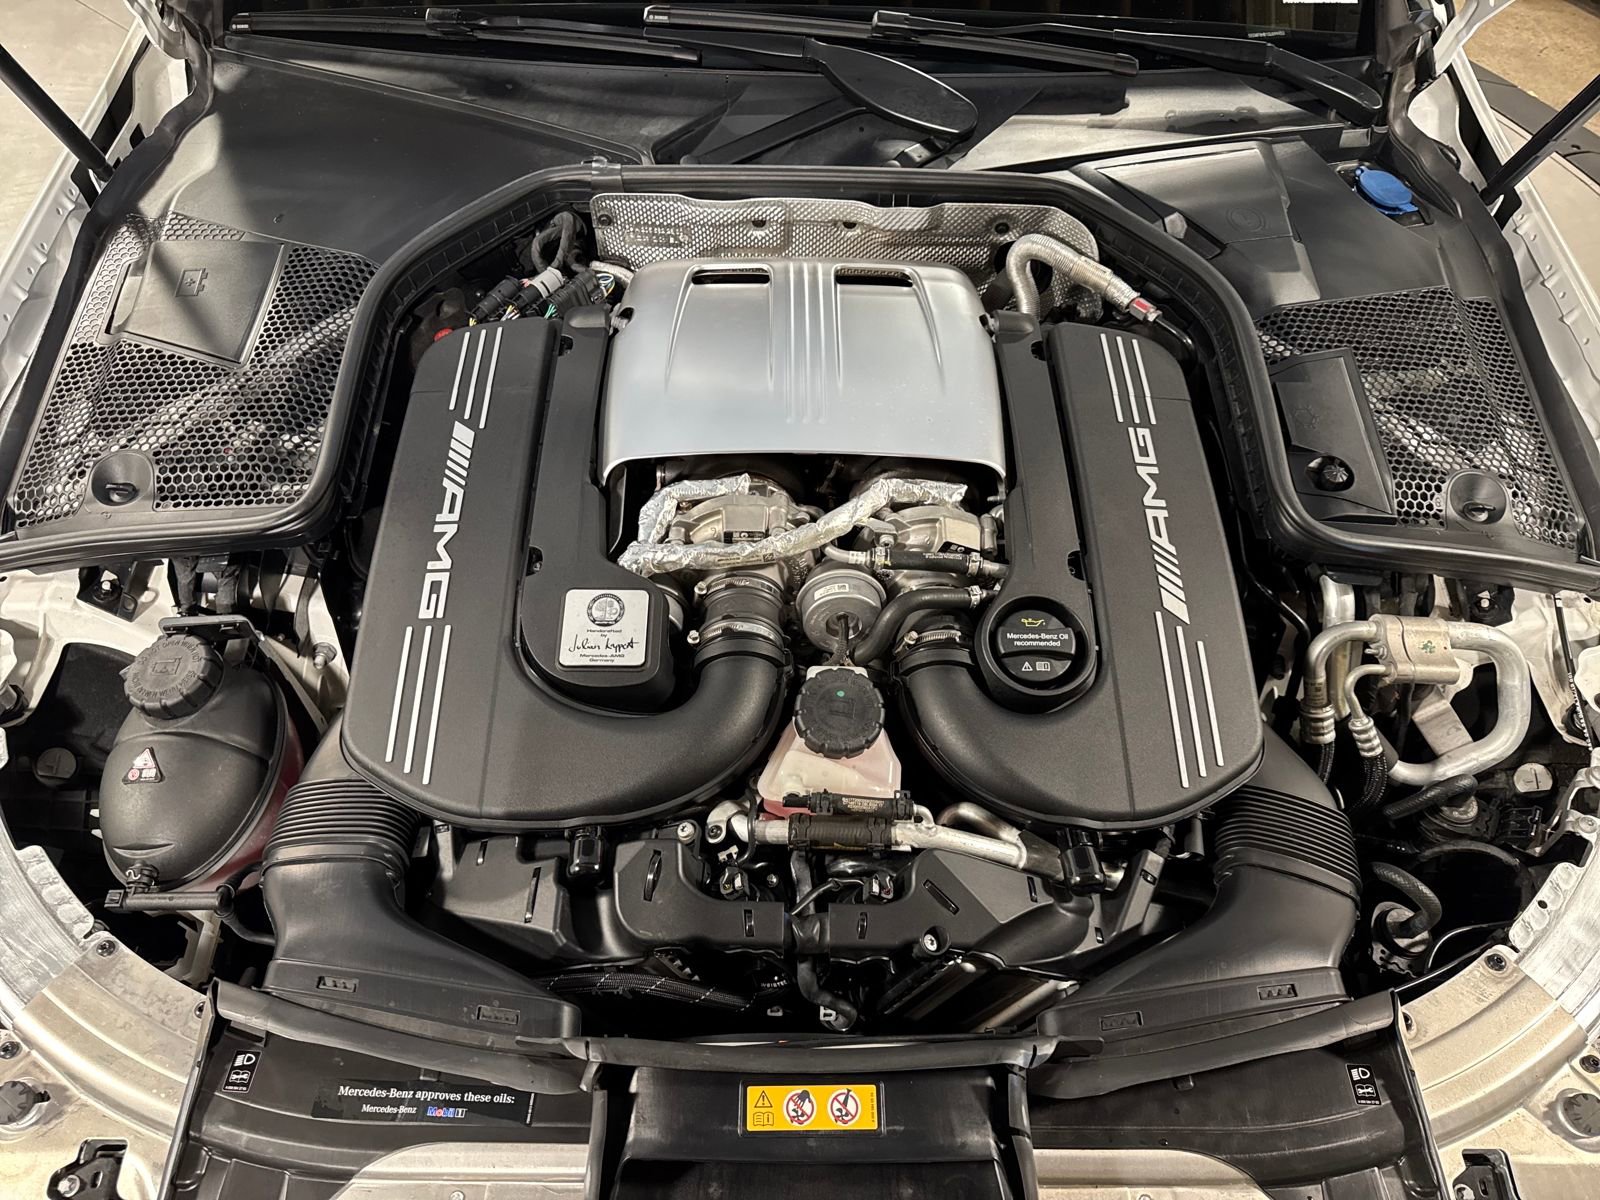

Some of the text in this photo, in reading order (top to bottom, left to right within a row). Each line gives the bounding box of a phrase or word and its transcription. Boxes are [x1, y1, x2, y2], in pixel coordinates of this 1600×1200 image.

[1006, 632, 1058, 640] Mercedes-Benz
[337, 1085, 515, 1104] Mercedes-Benz approves these oils:
[361, 1103, 417, 1114] Mercedes-Benz
[427, 1106, 455, 1117] Mobil
